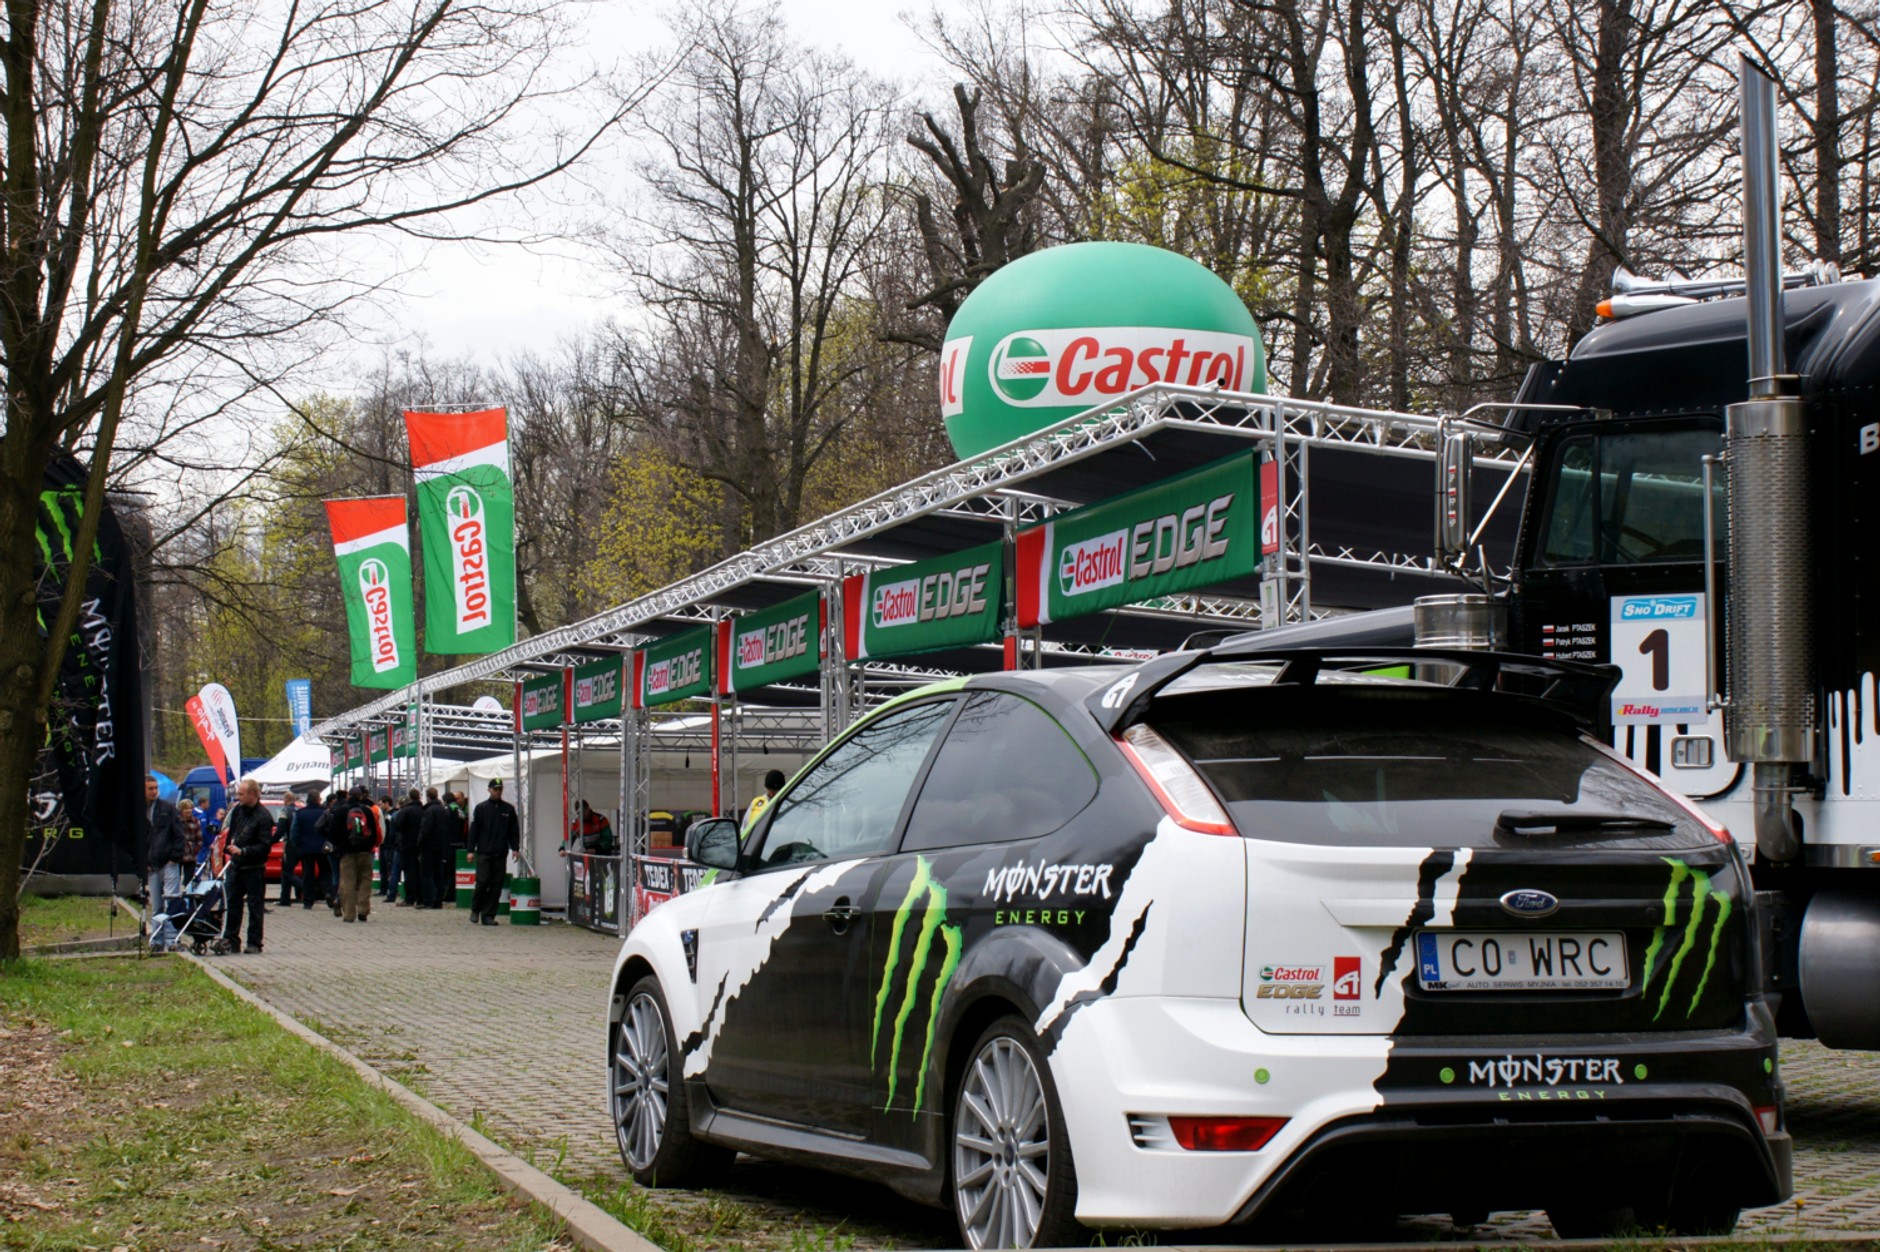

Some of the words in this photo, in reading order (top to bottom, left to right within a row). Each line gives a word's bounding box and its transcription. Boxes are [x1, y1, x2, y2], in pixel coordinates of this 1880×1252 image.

[1055, 337, 1245, 397] Castrol
[1074, 535, 1125, 588] Castrol
[1128, 493, 1235, 581] EDGE
[882, 582, 917, 622] Castrol
[919, 563, 991, 622] EDGE
[743, 632, 765, 664] Castrol
[765, 613, 809, 664] EDGE
[1638, 628, 1669, 691] 1
[669, 648, 702, 691] EDGE
[81, 598, 115, 767] MOTER
[1622, 703, 1660, 718] Rally
[286, 761, 331, 772] Dynam
[1515, 893, 1546, 909] Ford
[995, 910, 1086, 925] ENERGY
[1529, 937, 1612, 977] WRC
[1274, 967, 1320, 981] Castrol
[1423, 964, 1437, 975] PL
[1256, 983, 1325, 999] EDGE
[1427, 981, 1448, 989] MK
[1466, 981, 1489, 989] AUTO
[1286, 1003, 1325, 1016] rally
[1334, 1004, 1361, 1014] team
[1498, 1090, 1606, 1101] ENERGY
